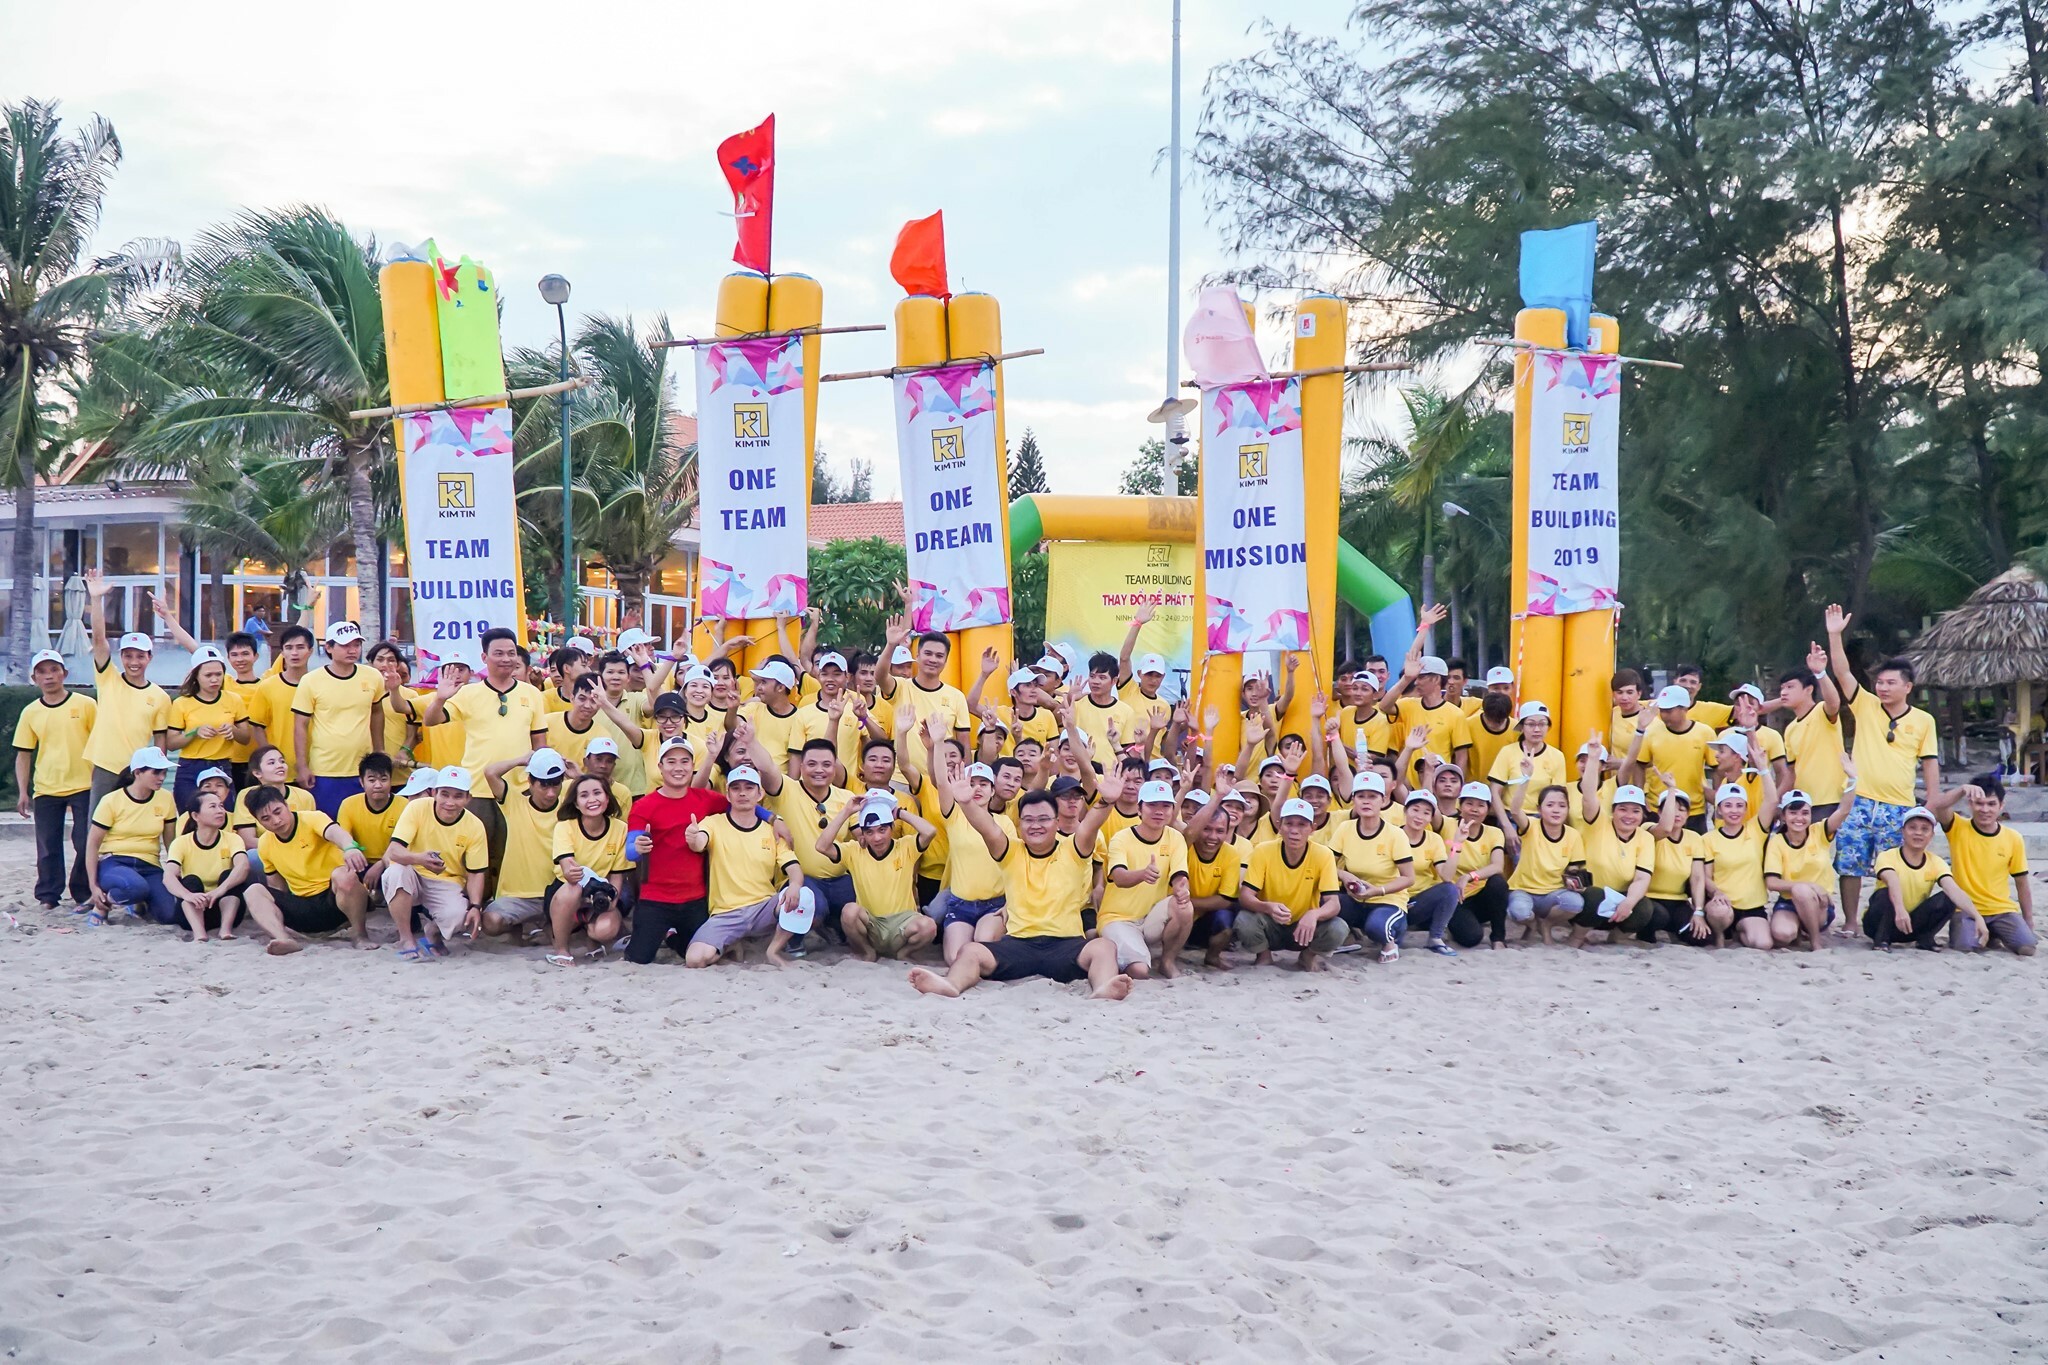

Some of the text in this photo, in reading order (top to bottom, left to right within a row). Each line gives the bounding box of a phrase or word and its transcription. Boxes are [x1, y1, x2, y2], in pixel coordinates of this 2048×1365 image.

[735, 439, 770, 448] KIM TIN
[934, 460, 966, 471] KIM TIN
[729, 467, 776, 491] ONE
[1240, 478, 1268, 488] KIM TIN
[1552, 472, 1599, 491] TEAM
[930, 485, 973, 512] ONE
[439, 510, 476, 518] KIM TIN
[720, 506, 786, 531] TEAM
[1233, 505, 1277, 529] ONE
[1531, 509, 1617, 529] BUILDING
[915, 522, 993, 553] DREAM
[426, 538, 490, 559] TEAM
[1205, 542, 1307, 570] MISSION
[1554, 546, 1599, 567] 2019
[1125, 574, 1192, 586] TEAM BUILDING
[1102, 594, 1127, 606] THAY
[432, 619, 490, 640] 2019
